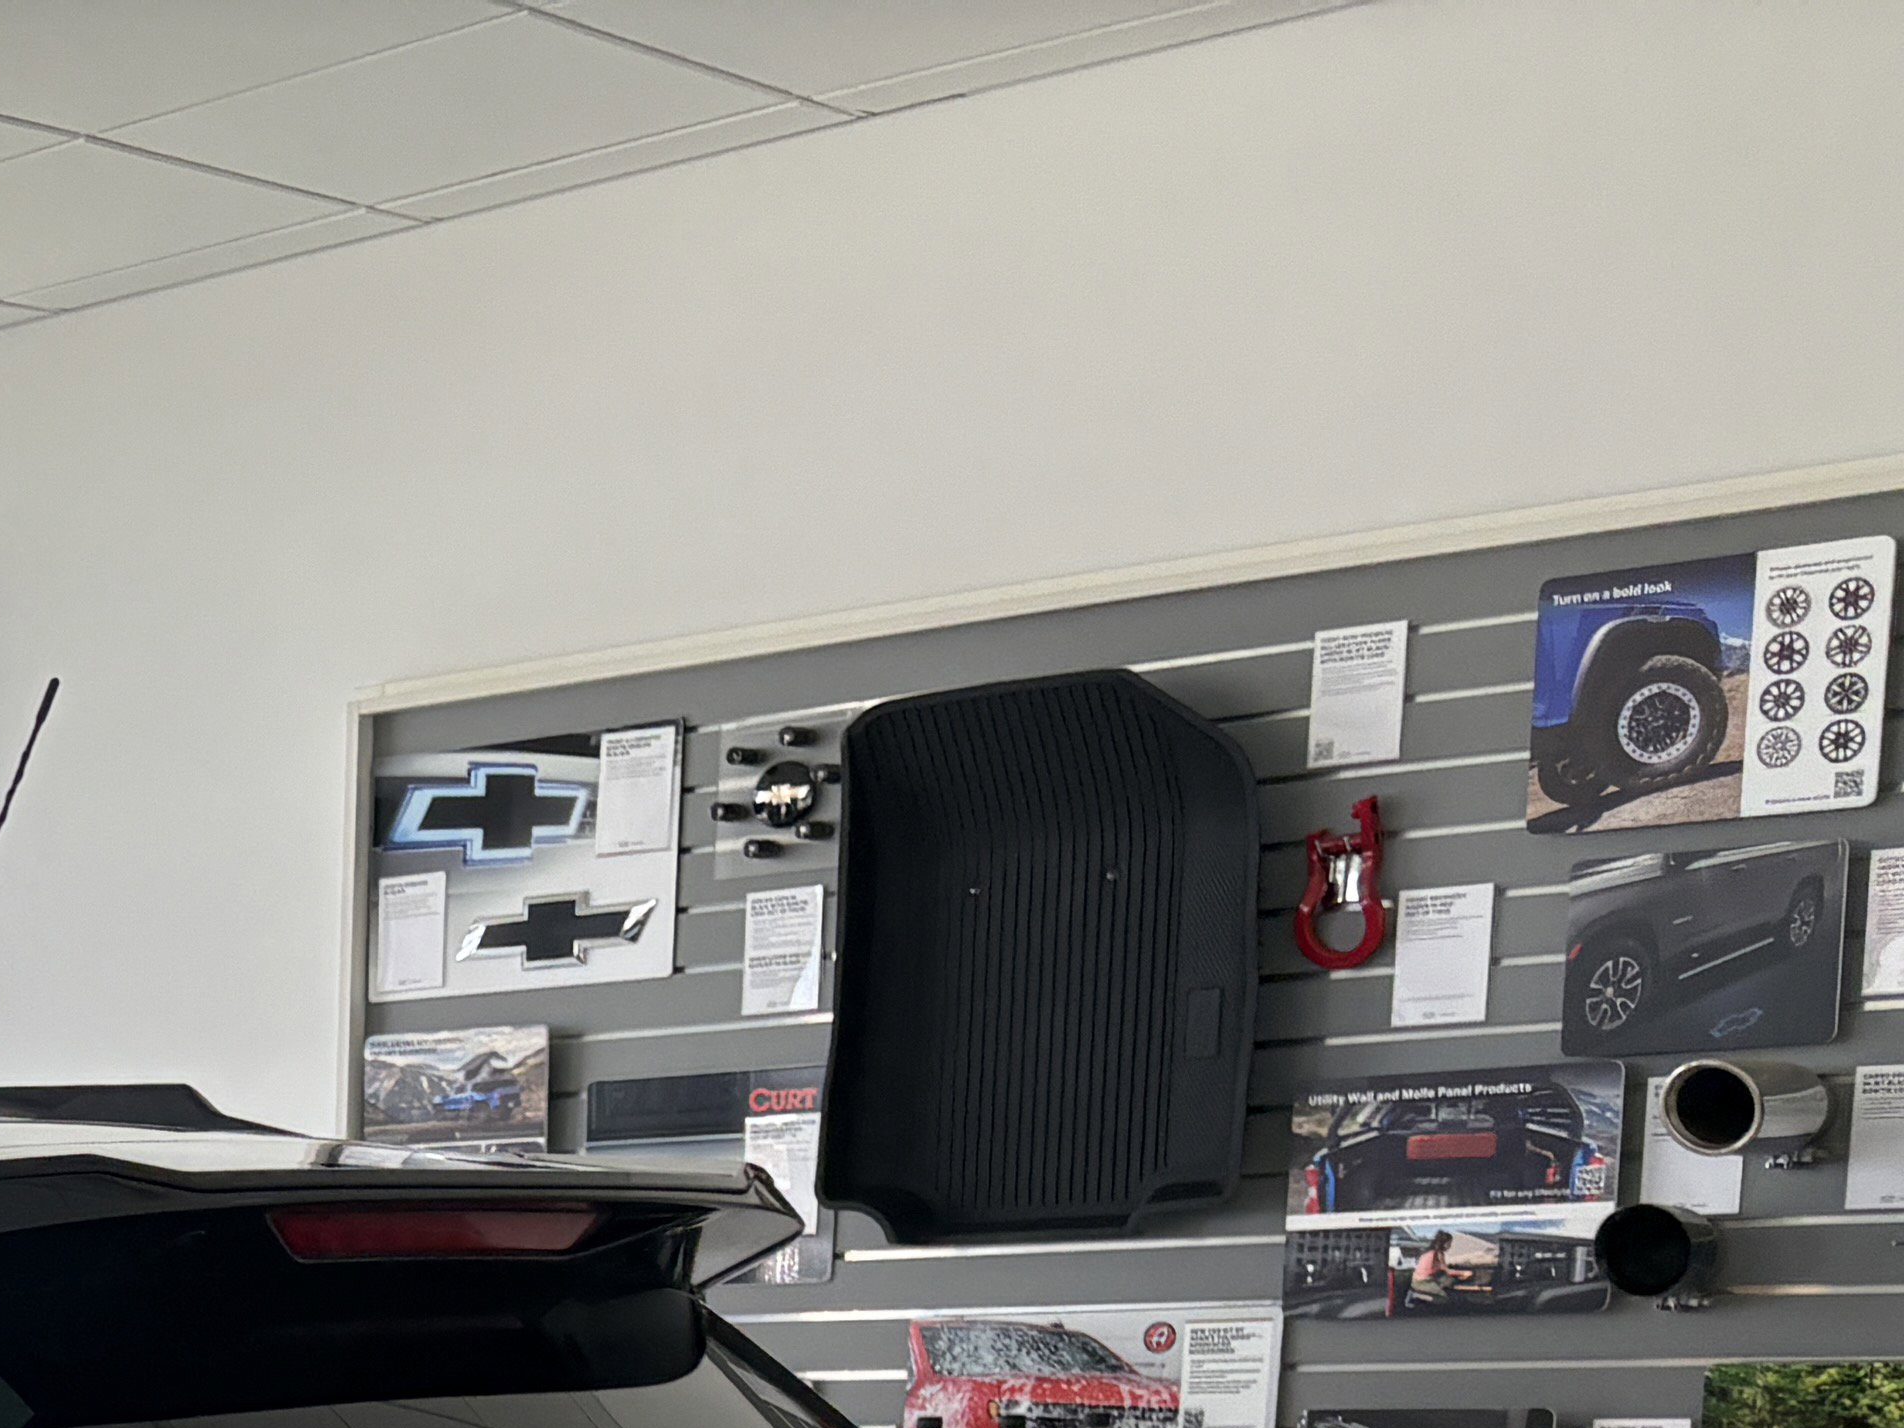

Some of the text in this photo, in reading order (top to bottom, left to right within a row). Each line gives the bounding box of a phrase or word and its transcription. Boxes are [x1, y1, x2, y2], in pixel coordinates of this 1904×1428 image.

[1552, 580, 1672, 606] Turn on a bold look
[749, 1088, 818, 1112] CURT
[1308, 1093, 1346, 1107] Utility
[1348, 1090, 1374, 1104] Wall
[1376, 1089, 1400, 1102] and
[1438, 1084, 1472, 1098] Panel
[1475, 1082, 1532, 1097] Products
